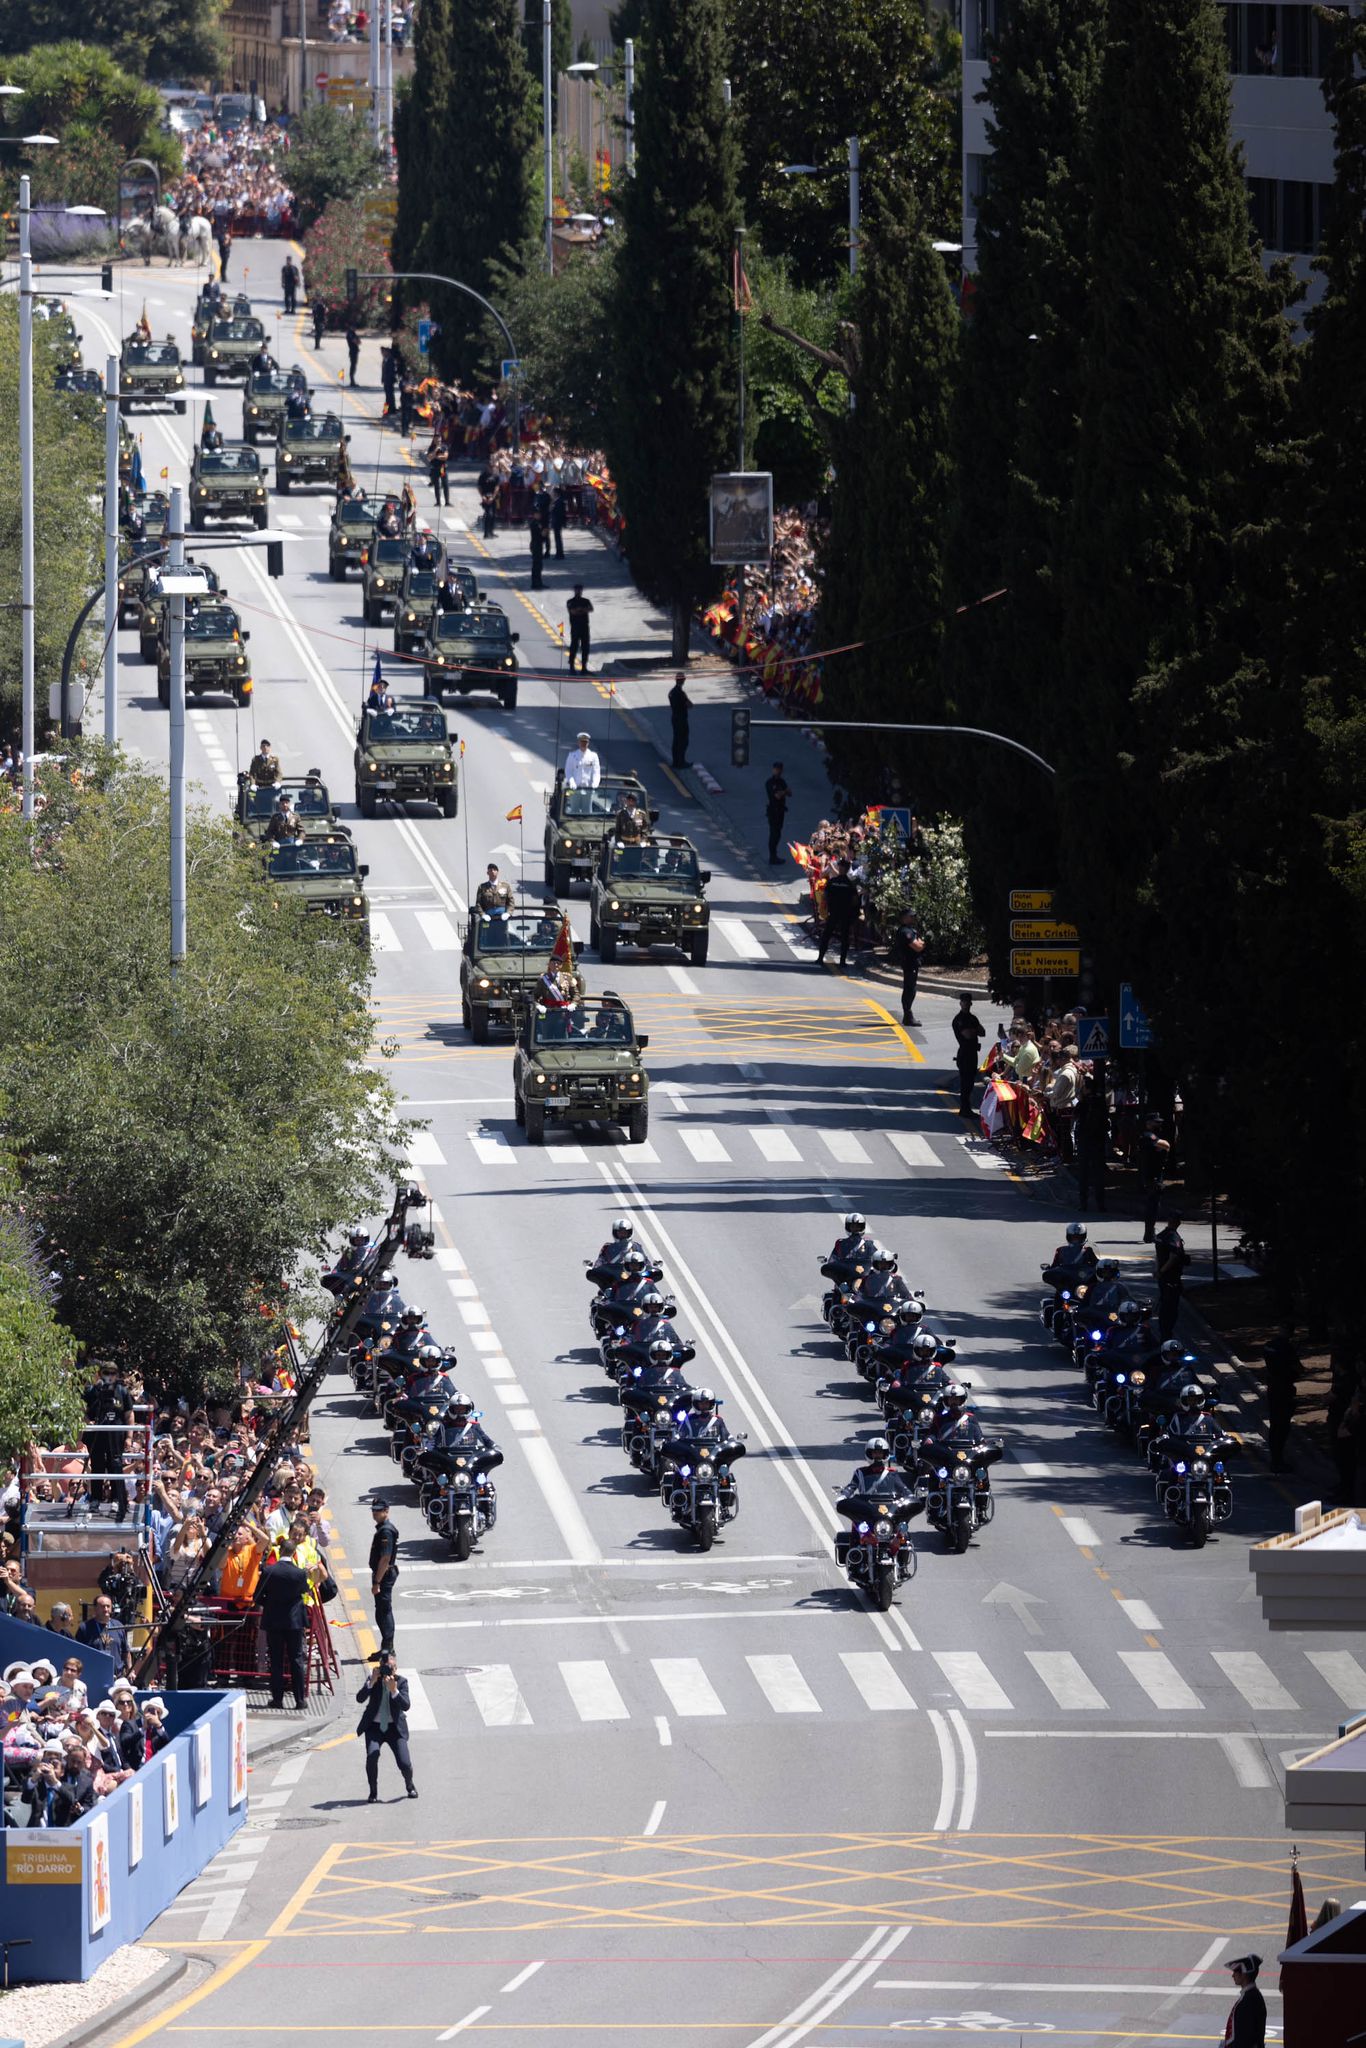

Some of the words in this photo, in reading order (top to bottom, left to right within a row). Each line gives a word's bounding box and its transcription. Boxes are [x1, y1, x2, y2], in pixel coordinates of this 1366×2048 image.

[1014, 900, 1033, 909] Don
[1014, 929, 1041, 938] Reina
[1044, 929, 1078, 938] Cristin
[1014, 958, 1031, 966] Las
[1036, 957, 1069, 966] Nieves
[1014, 966, 1074, 974] Sacromonte
[22, 1853, 67, 1863] TRIBUNA
